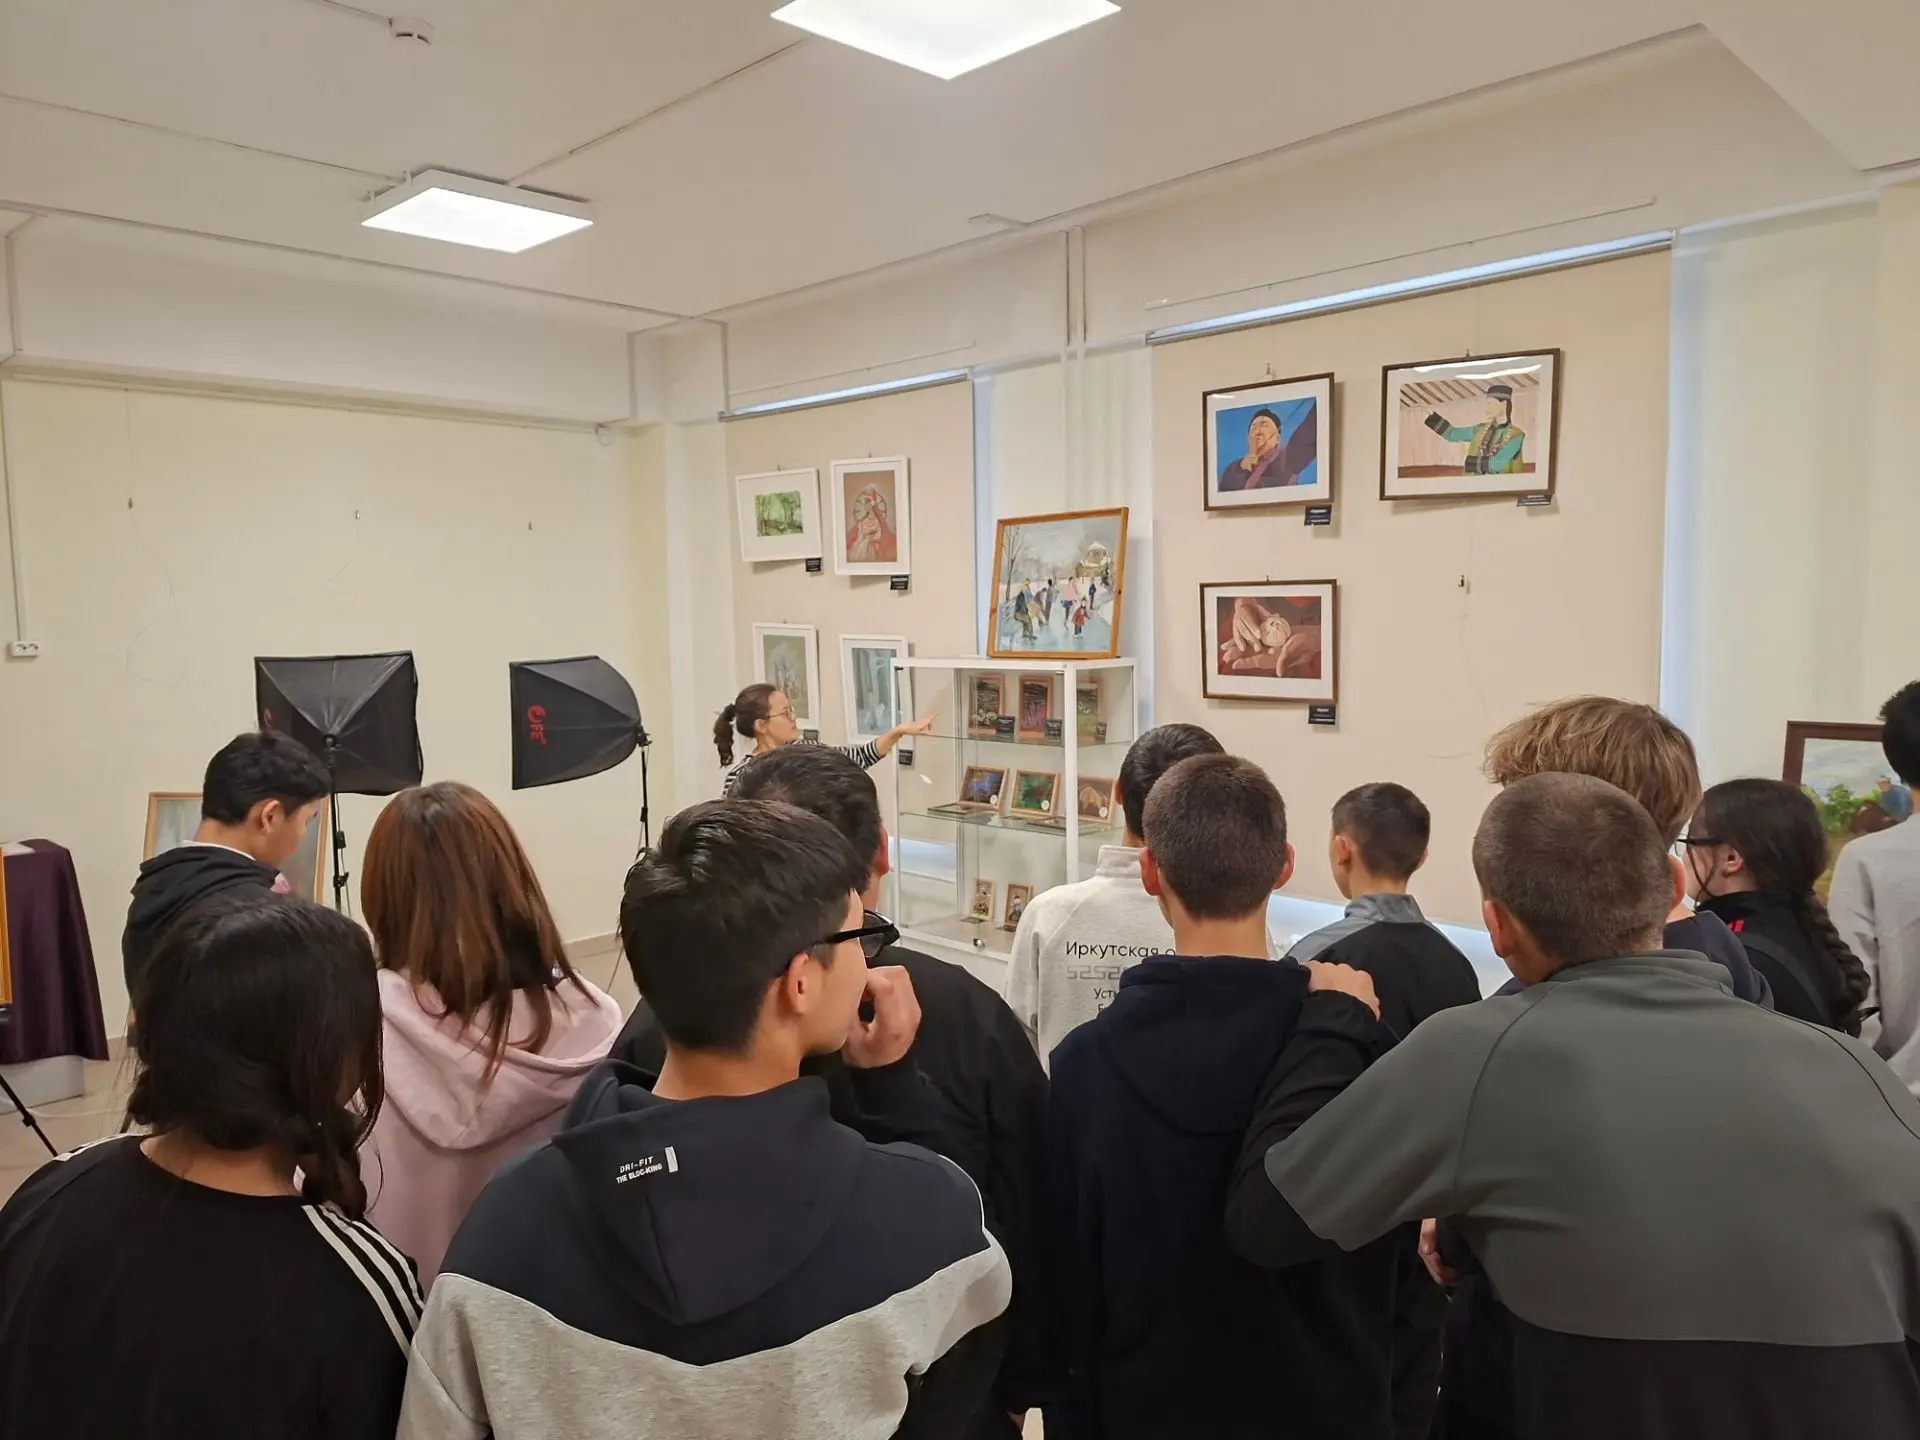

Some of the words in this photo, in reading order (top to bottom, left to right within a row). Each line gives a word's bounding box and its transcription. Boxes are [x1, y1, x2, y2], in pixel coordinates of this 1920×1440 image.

[1066, 941, 1158, 959] Иркутская
[620, 1156, 654, 1173] DRI-FIT
[616, 1174, 628, 1184] THE
